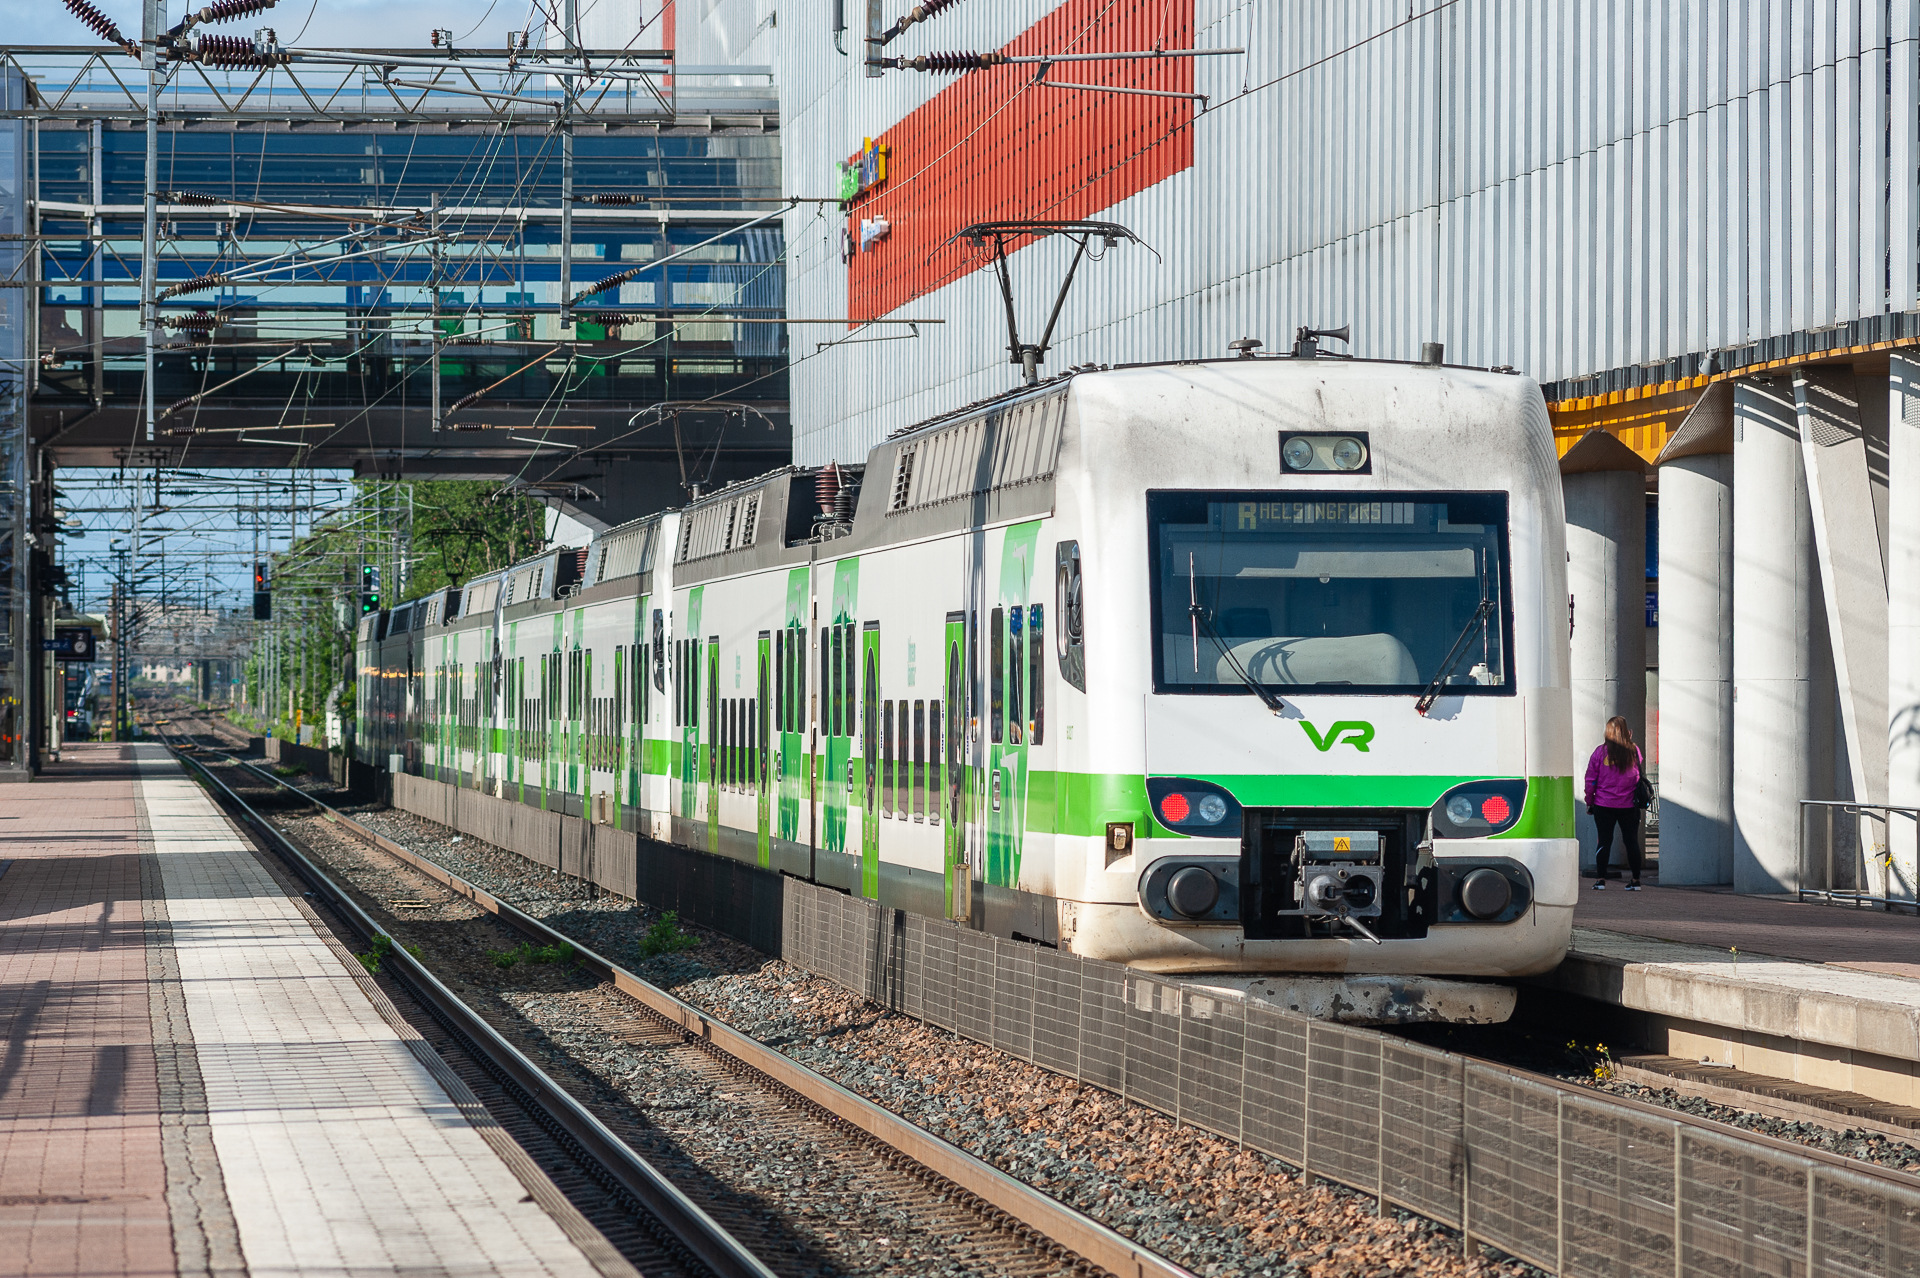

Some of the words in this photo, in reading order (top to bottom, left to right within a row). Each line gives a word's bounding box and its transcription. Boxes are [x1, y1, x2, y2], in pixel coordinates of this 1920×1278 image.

[1238, 502, 1257, 530] R
[1260, 503, 1381, 520] HELSINGFORS
[77, 632, 84, 640] 2
[1298, 720, 1375, 752] VR
